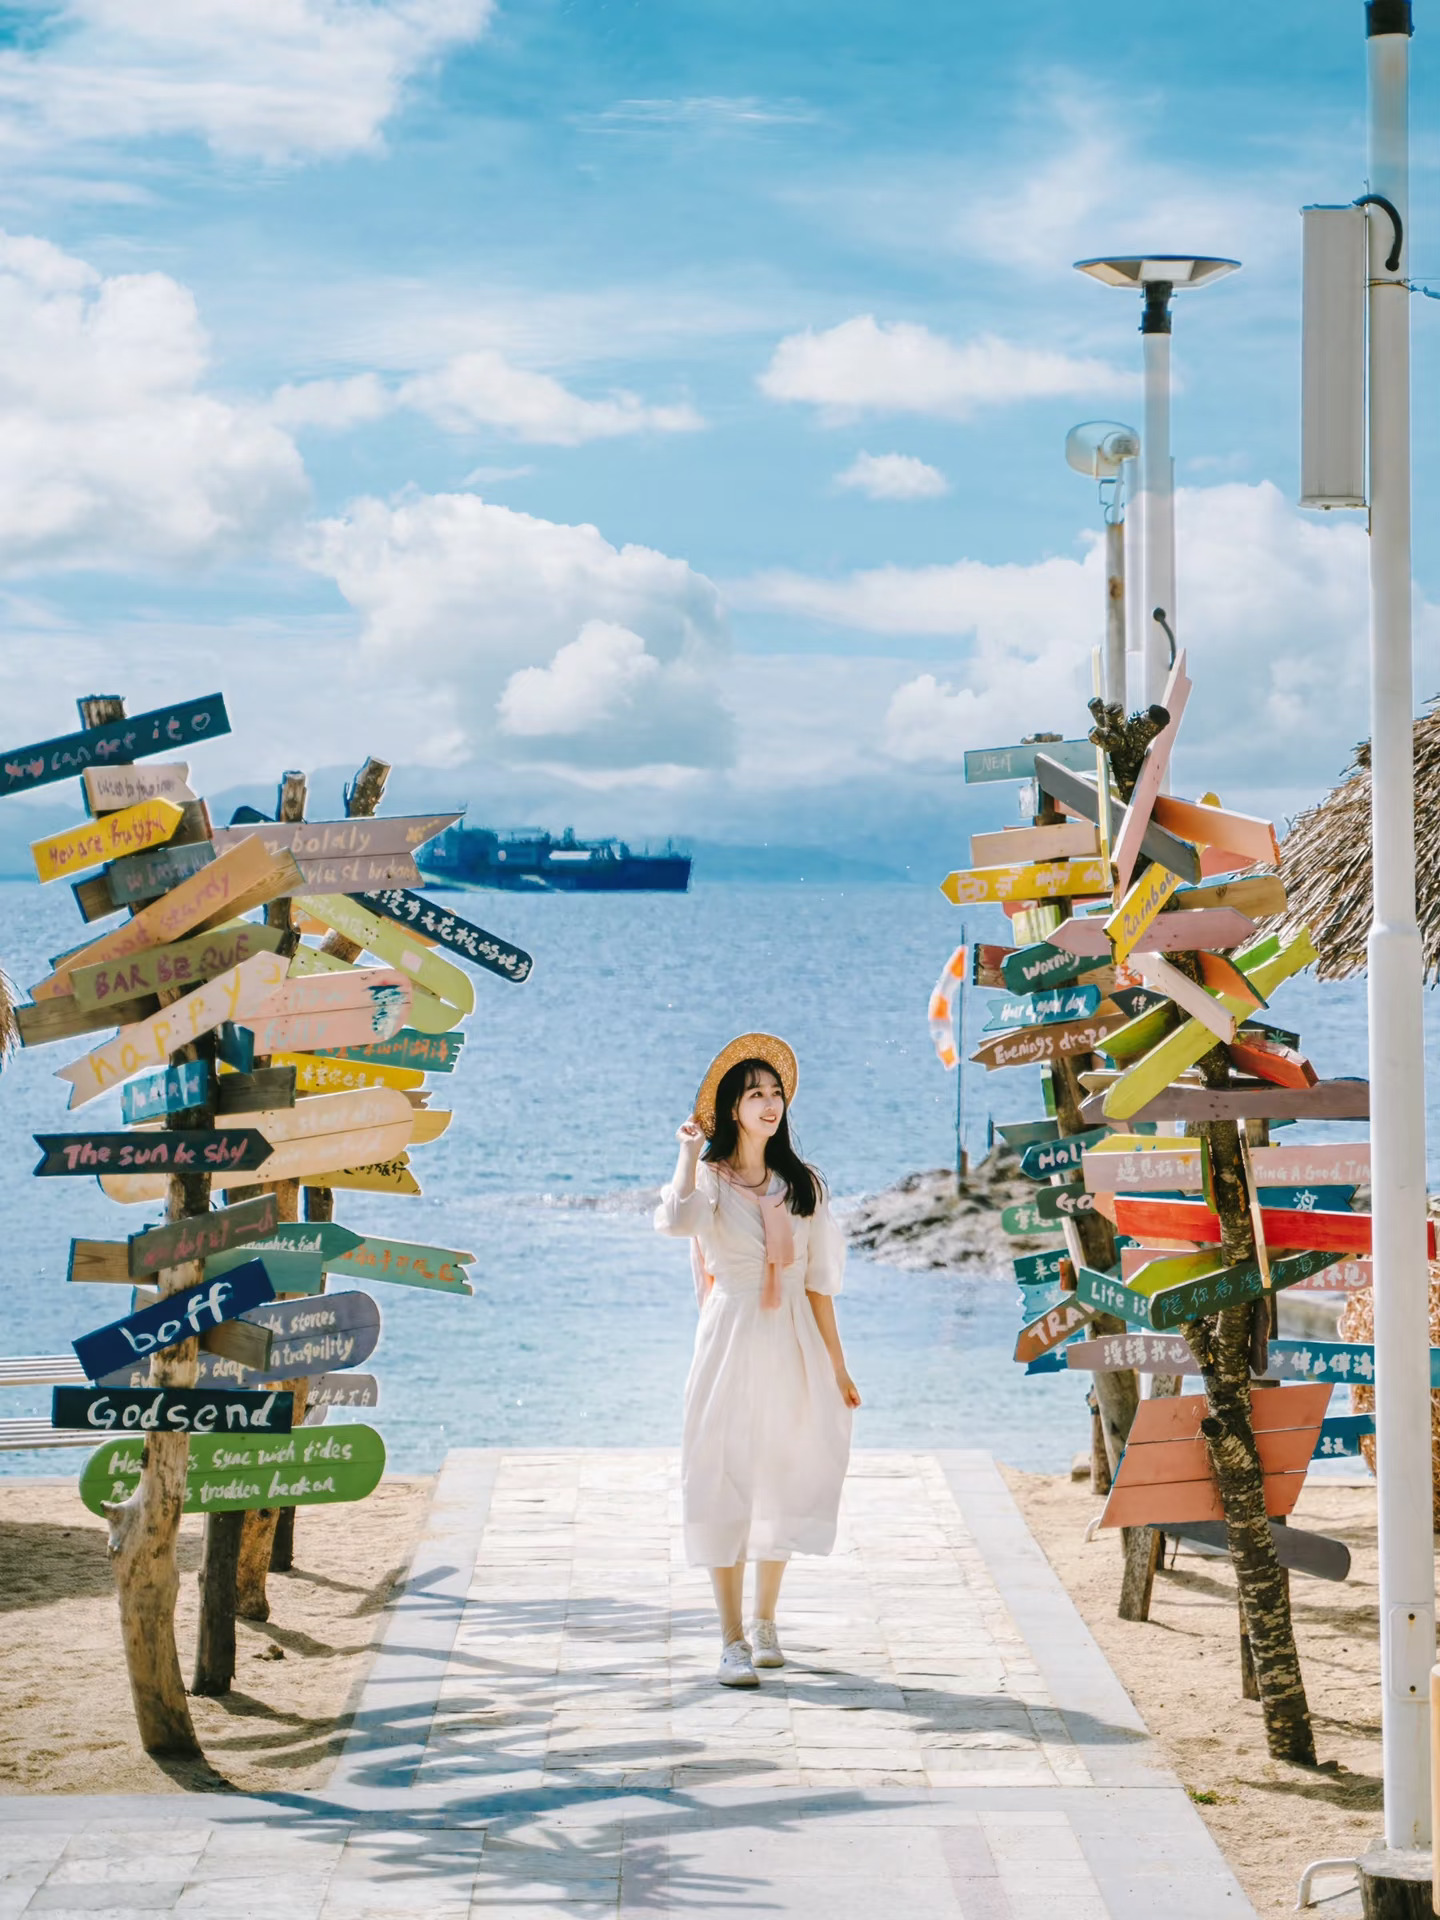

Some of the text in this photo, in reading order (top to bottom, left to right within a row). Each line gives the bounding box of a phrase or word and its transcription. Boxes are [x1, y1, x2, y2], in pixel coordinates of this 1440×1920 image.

[95, 963, 150, 1000] BAR
[993, 1034, 1054, 1065] Evenings
[63, 1141, 110, 1170] The
[119, 1143, 168, 1165] sun
[1090, 1281, 1125, 1309] Life
[1133, 1296, 1148, 1317] is
[87, 1392, 276, 1432] Godsend
[304, 1435, 353, 1463] tides
